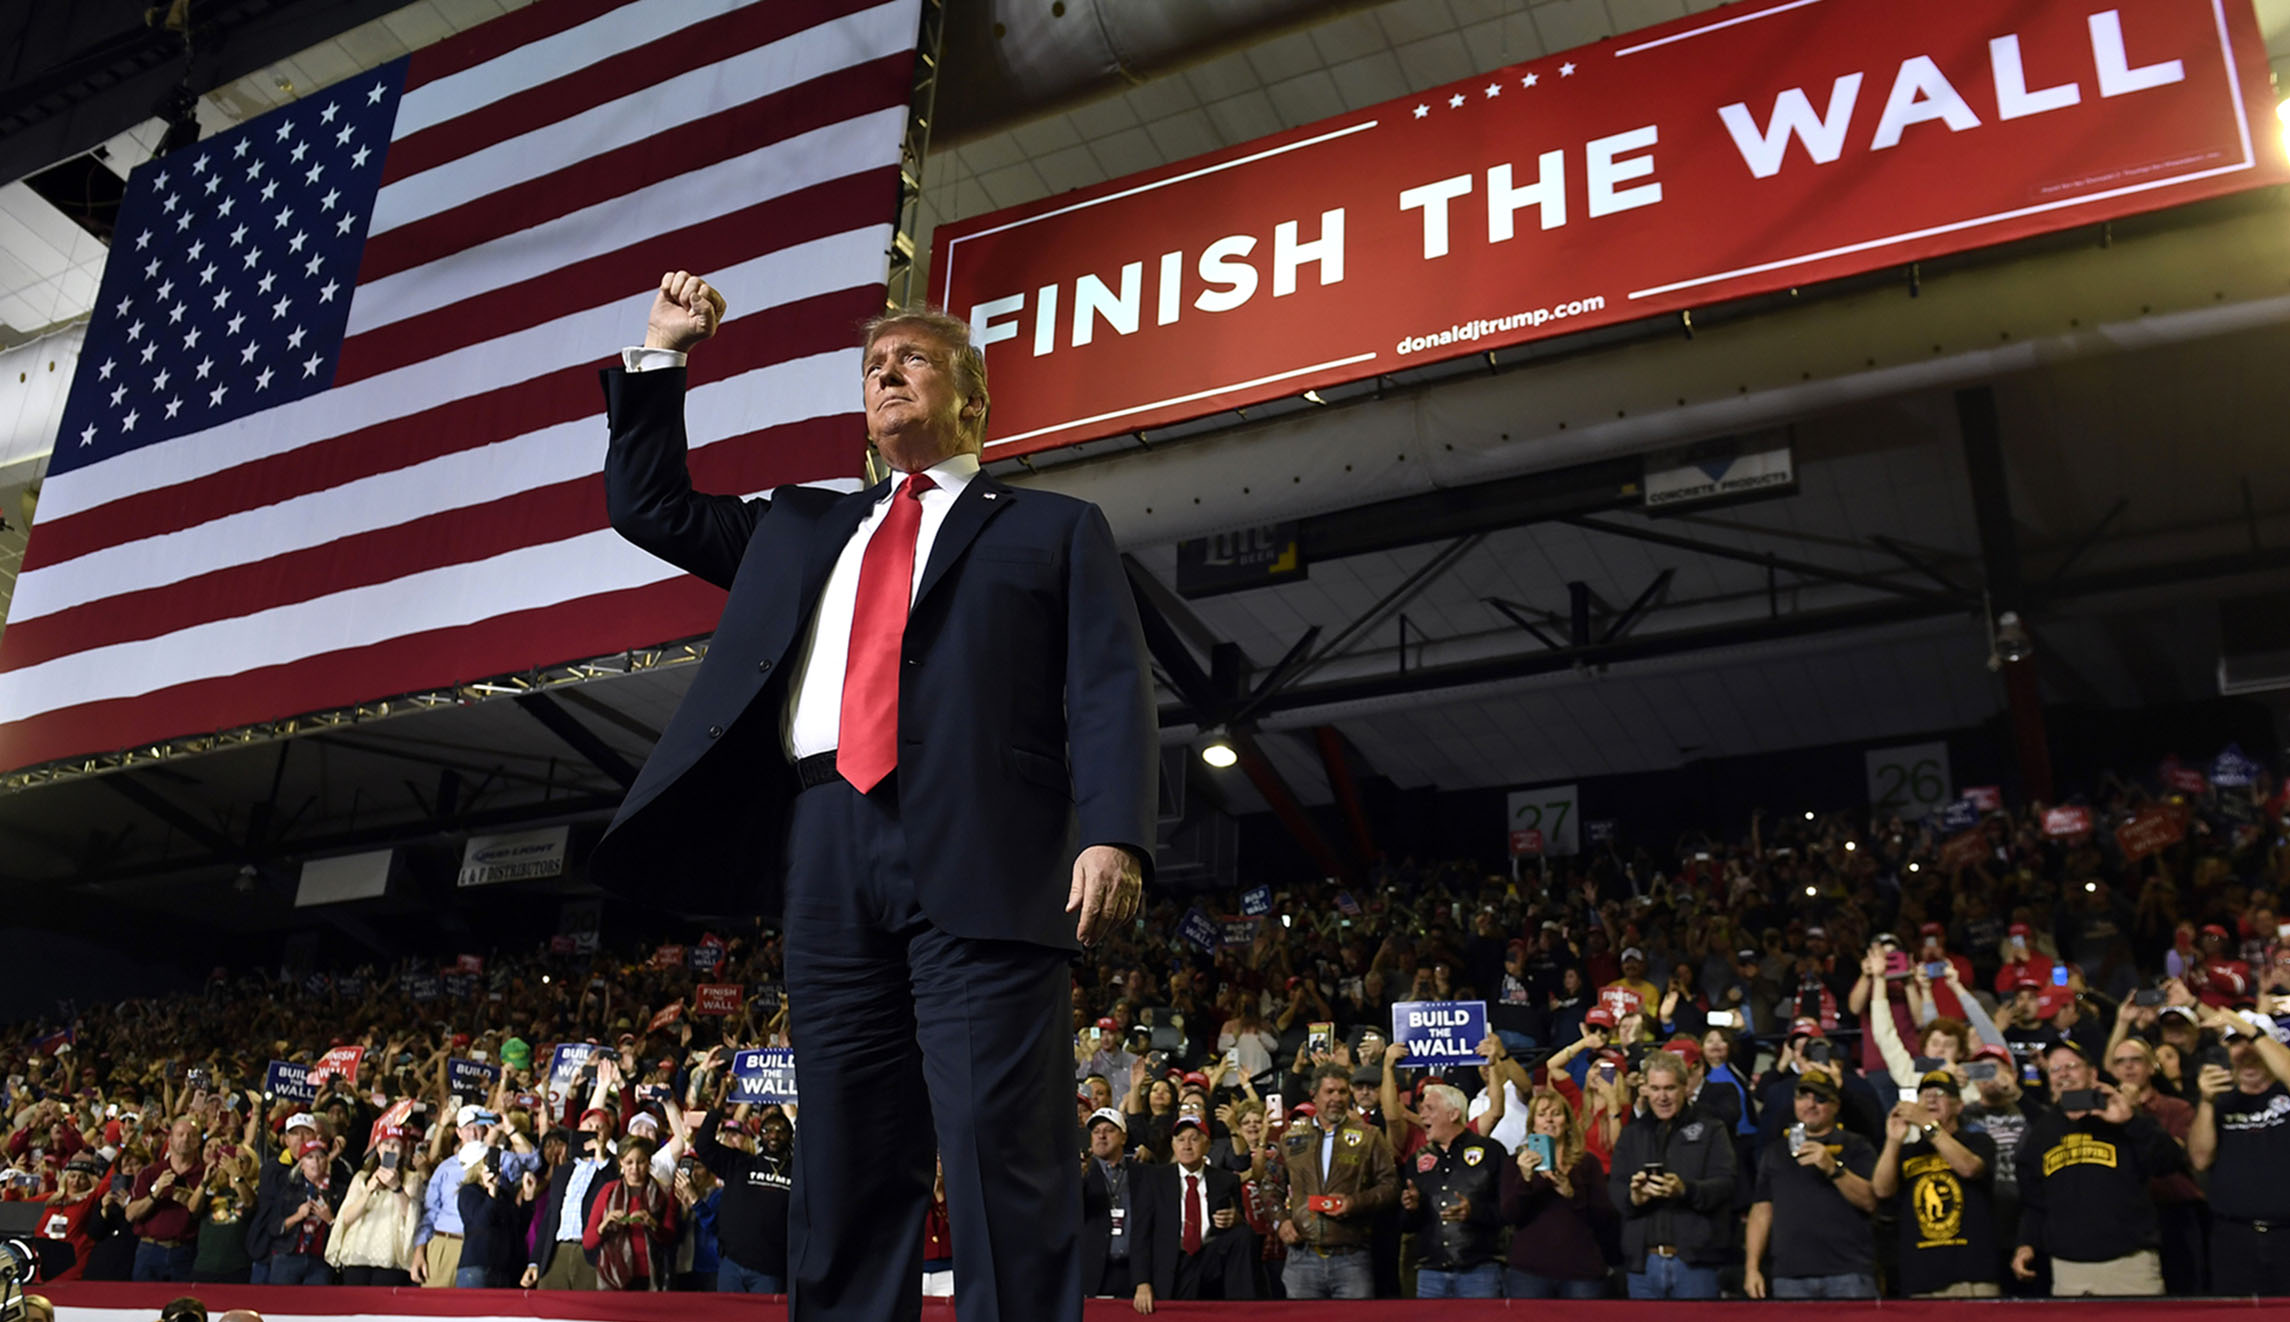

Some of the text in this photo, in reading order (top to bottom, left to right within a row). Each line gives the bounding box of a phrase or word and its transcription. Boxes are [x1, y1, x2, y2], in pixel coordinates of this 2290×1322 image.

[970, 9, 2186, 358] FINISH THE WALL
[1396, 295, 1605, 354] donaldjtrump.com
[1649, 471, 1787, 503] CONCRETE PRODUCTS
[1240, 549, 1274, 566] BEER
[1876, 758, 1945, 808] 26
[1516, 800, 1572, 843] 27
[487, 858, 561, 881] DISTRIBUTORS
[1184, 925, 1212, 948] WALL
[694, 959, 717, 967] WALL
[703, 987, 737, 997] FINISH
[703, 1000, 735, 1010] WALL
[1408, 1009, 1470, 1028] BUILD
[1428, 1027, 1451, 1038] THE
[561, 1047, 588, 1060] BUIL
[1408, 1037, 1474, 1057] WALL
[278, 1066, 307, 1080] BUIL
[456, 1063, 492, 1079] BUILD
[761, 1069, 782, 1078] THE
[274, 1082, 315, 1099] WALL
[742, 1078, 798, 1096] WALL
[749, 1171, 792, 1186] TRUMP
